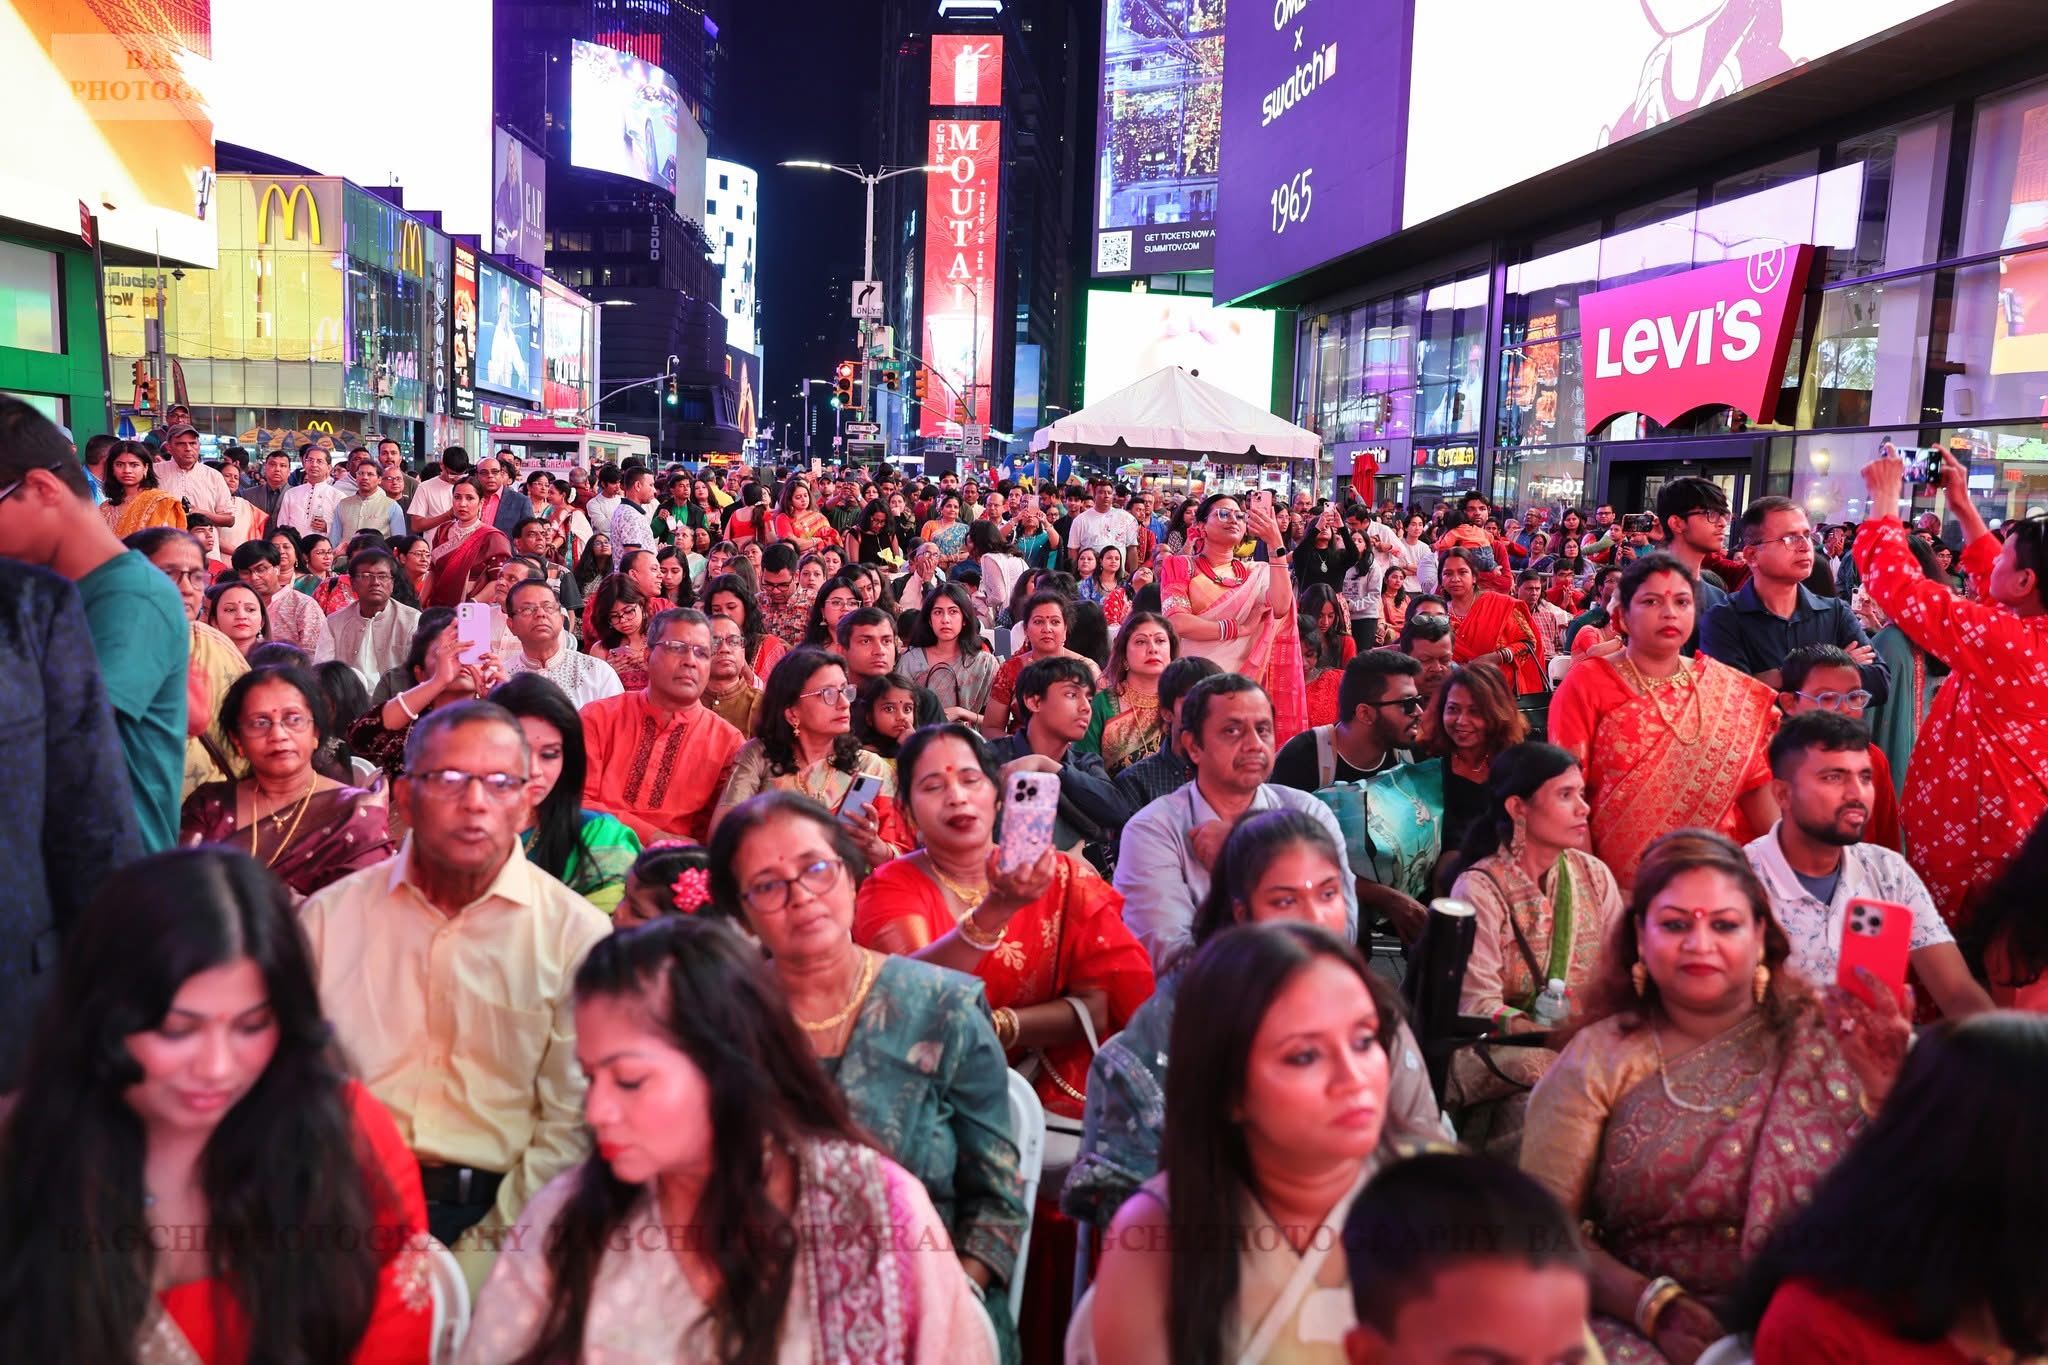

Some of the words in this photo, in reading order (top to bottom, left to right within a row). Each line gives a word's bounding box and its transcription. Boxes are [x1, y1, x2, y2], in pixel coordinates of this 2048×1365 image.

[526, 182, 542, 229] GAP
[1271, 168, 1312, 234] 1965
[947, 124, 980, 310] MOUTAI
[650, 214, 660, 261] 1500
[1144, 233, 1160, 242] GET
[1161, 231, 1190, 241] TICKETS
[1191, 230, 1209, 239] NOW
[1144, 242, 1200, 253] SUMMITOV.COM
[857, 307, 877, 315] ONLY
[886, 362, 895, 370] 45
[966, 436, 981, 446] 25
